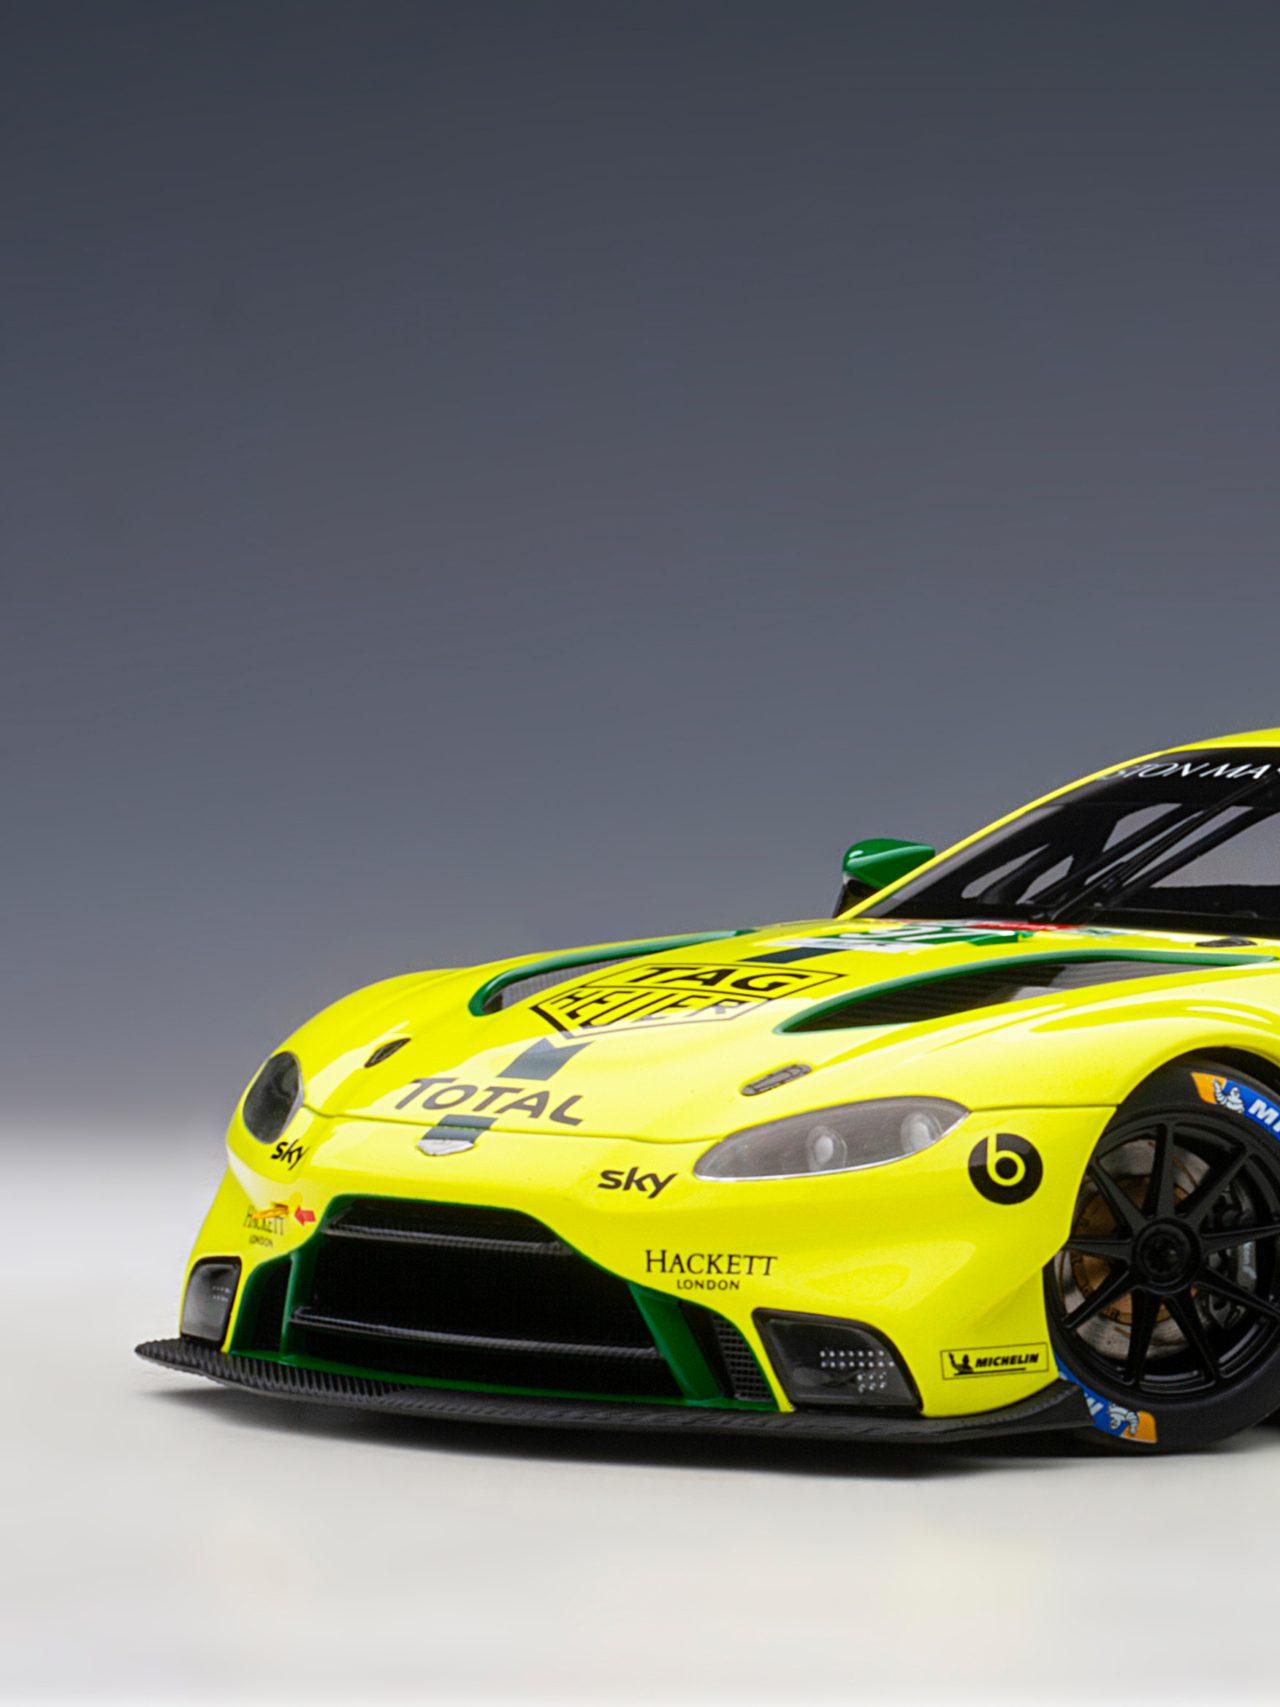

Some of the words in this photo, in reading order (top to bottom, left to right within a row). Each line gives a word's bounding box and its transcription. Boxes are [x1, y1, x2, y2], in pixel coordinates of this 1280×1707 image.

[626, 966, 812, 993] TAG
[550, 989, 750, 1030] HEUER
[394, 1076, 587, 1127] TOTAL
[270, 1138, 311, 1171] sky
[597, 1166, 678, 1199] sky
[645, 1249, 778, 1278] HACKETT
[676, 1278, 741, 1291] LONDON
[974, 1351, 1040, 1369] MICHELIN
